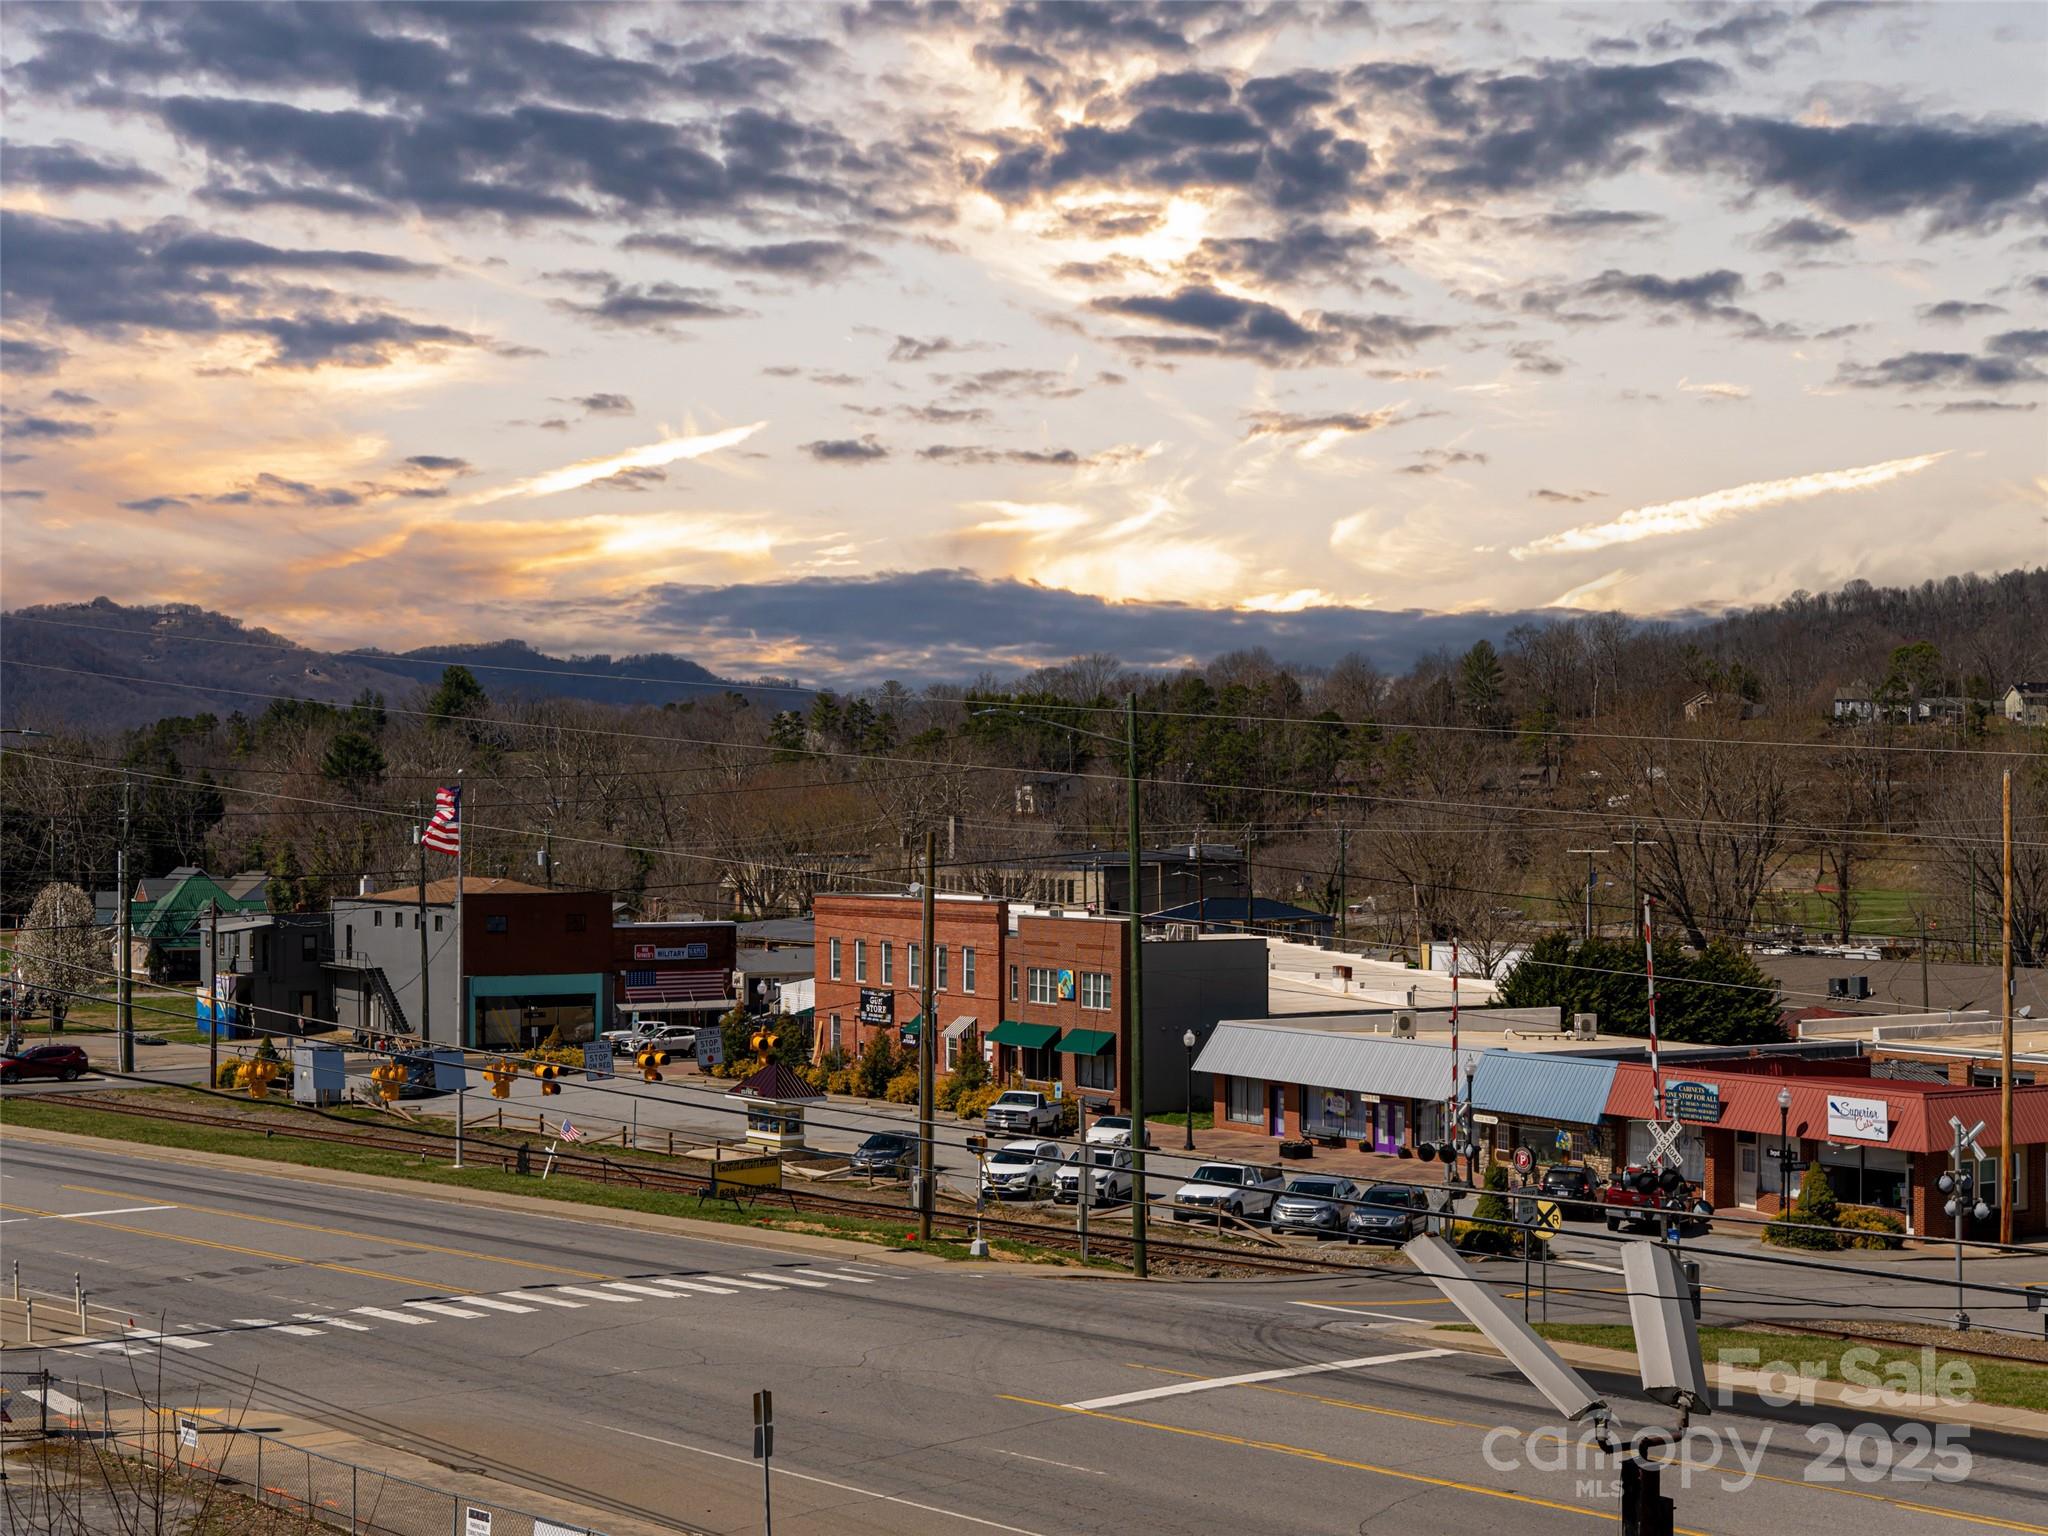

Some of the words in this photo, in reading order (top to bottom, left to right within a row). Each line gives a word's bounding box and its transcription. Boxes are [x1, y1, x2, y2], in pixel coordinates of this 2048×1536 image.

[866, 1004, 887, 1014] STORE
[700, 1039, 719, 1048] STOP
[700, 1048, 707, 1056] ON
[708, 1046, 720, 1054] RED
[589, 1053, 609, 1062] STOP
[598, 1061, 611, 1069] RED
[1679, 1085, 1705, 1094] CABINETS
[1840, 1101, 1879, 1120] Superior
[1856, 1117, 1873, 1131] Cuts
[1648, 1122, 1681, 1162] CROSSING
[1520, 1155, 1526, 1164] P
[1522, 1207, 1534, 1215] RED
[1552, 1214, 1560, 1224] R
